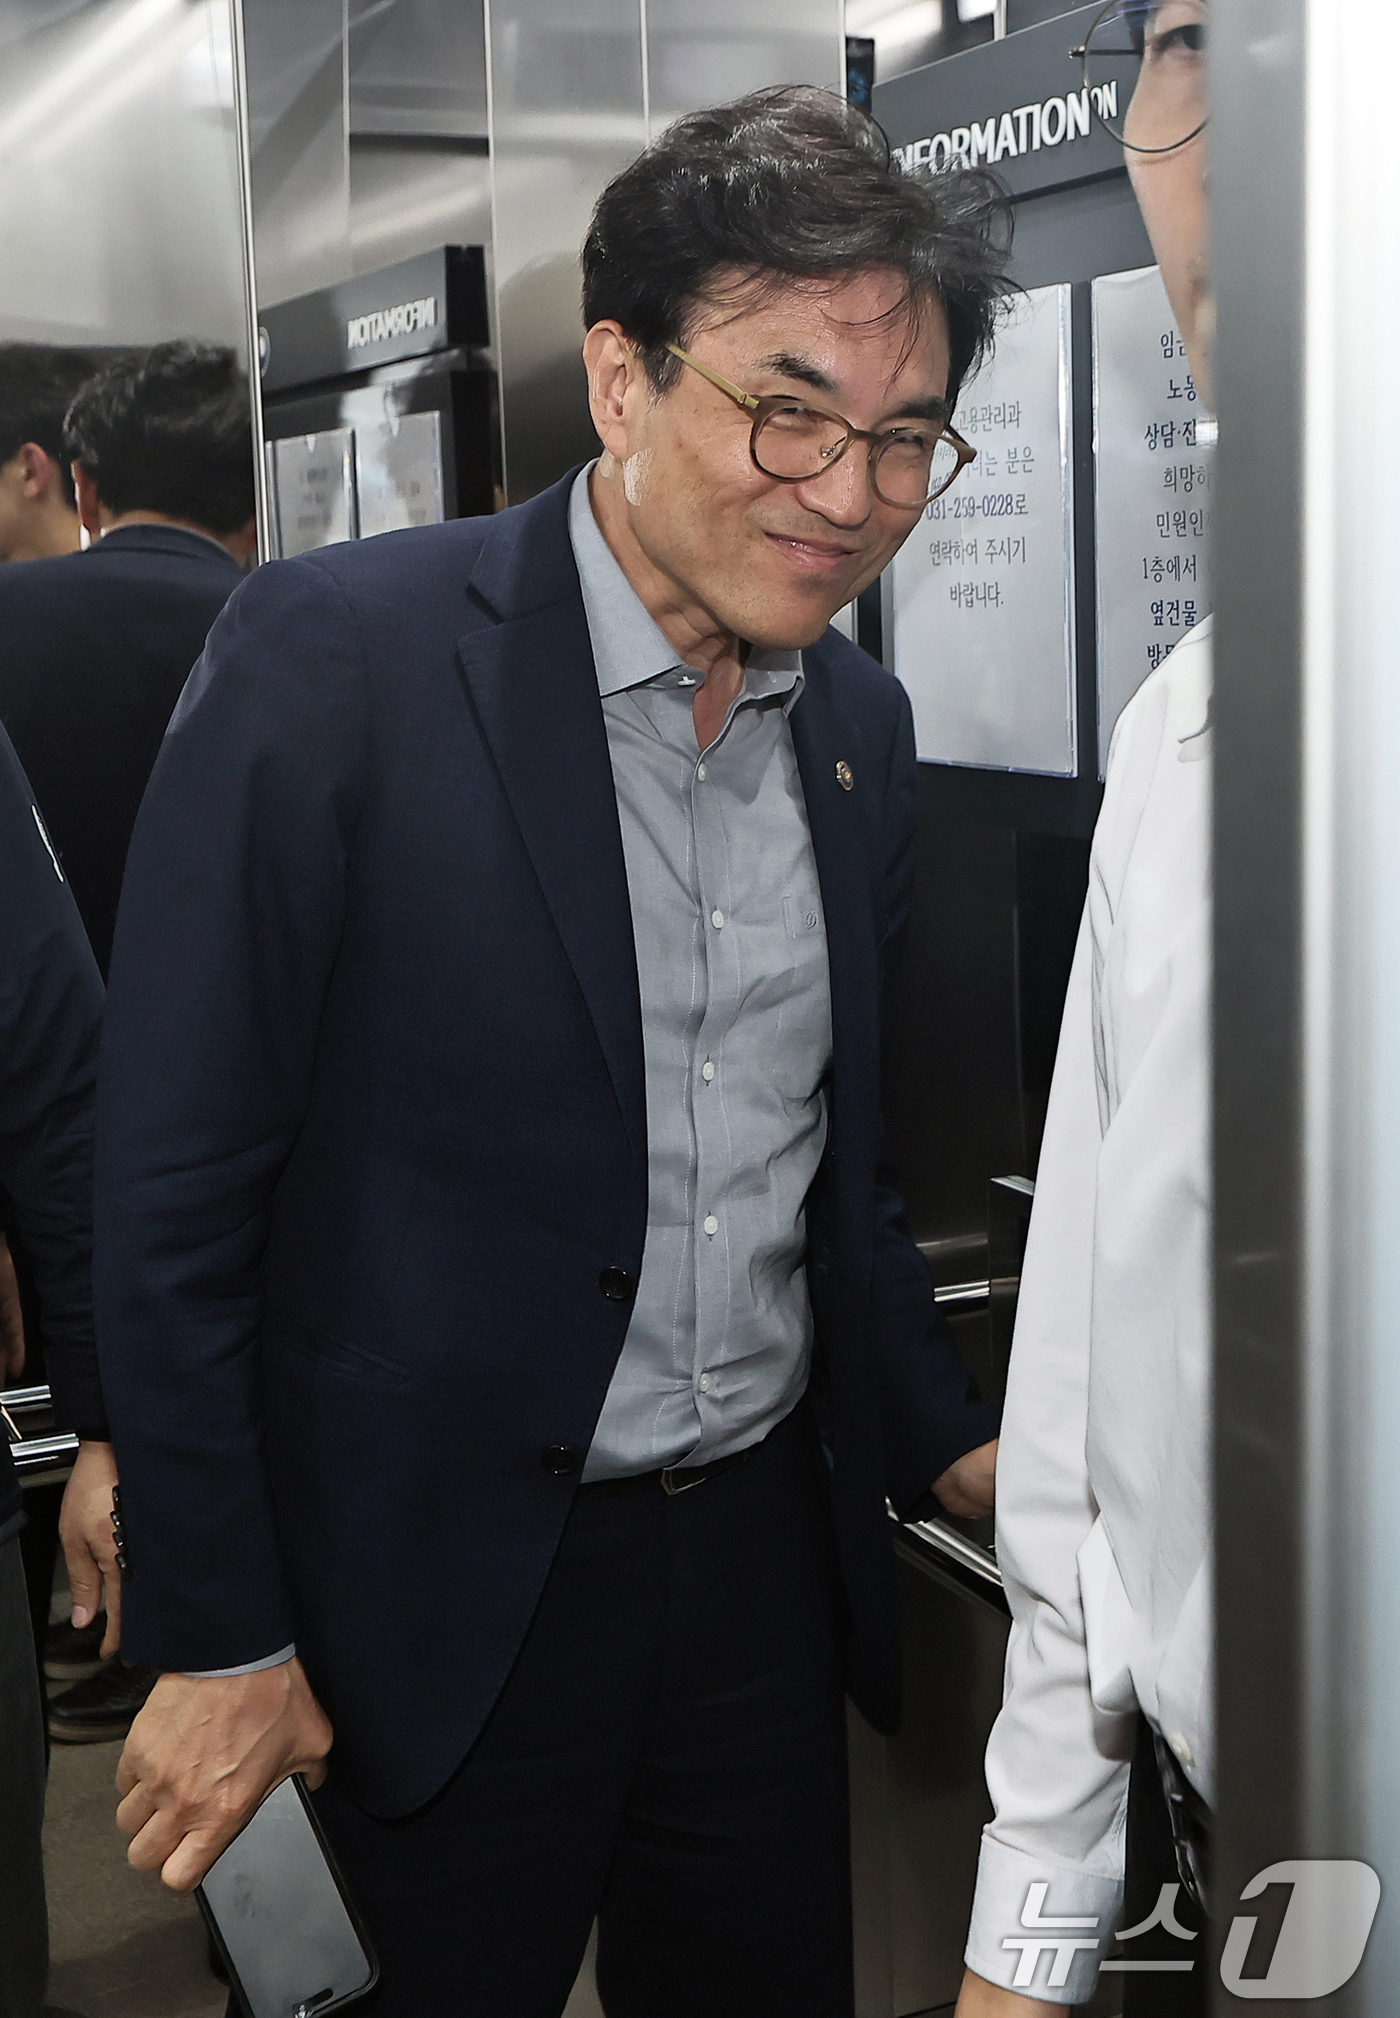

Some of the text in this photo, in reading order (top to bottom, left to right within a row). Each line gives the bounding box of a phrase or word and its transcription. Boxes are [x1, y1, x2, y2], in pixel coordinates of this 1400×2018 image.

[891, 88, 1091, 176] NFORMATION
[1005, 446, 1035, 475] 분은
[926, 493, 1029, 520] 031-259-0228로
[929, 536, 1026, 567] 연락하여 주시기
[1142, 554, 1197, 583] 1층에서
[950, 581, 1004, 609] 바랍니다.
[1150, 599, 1198, 627] 옆건물
